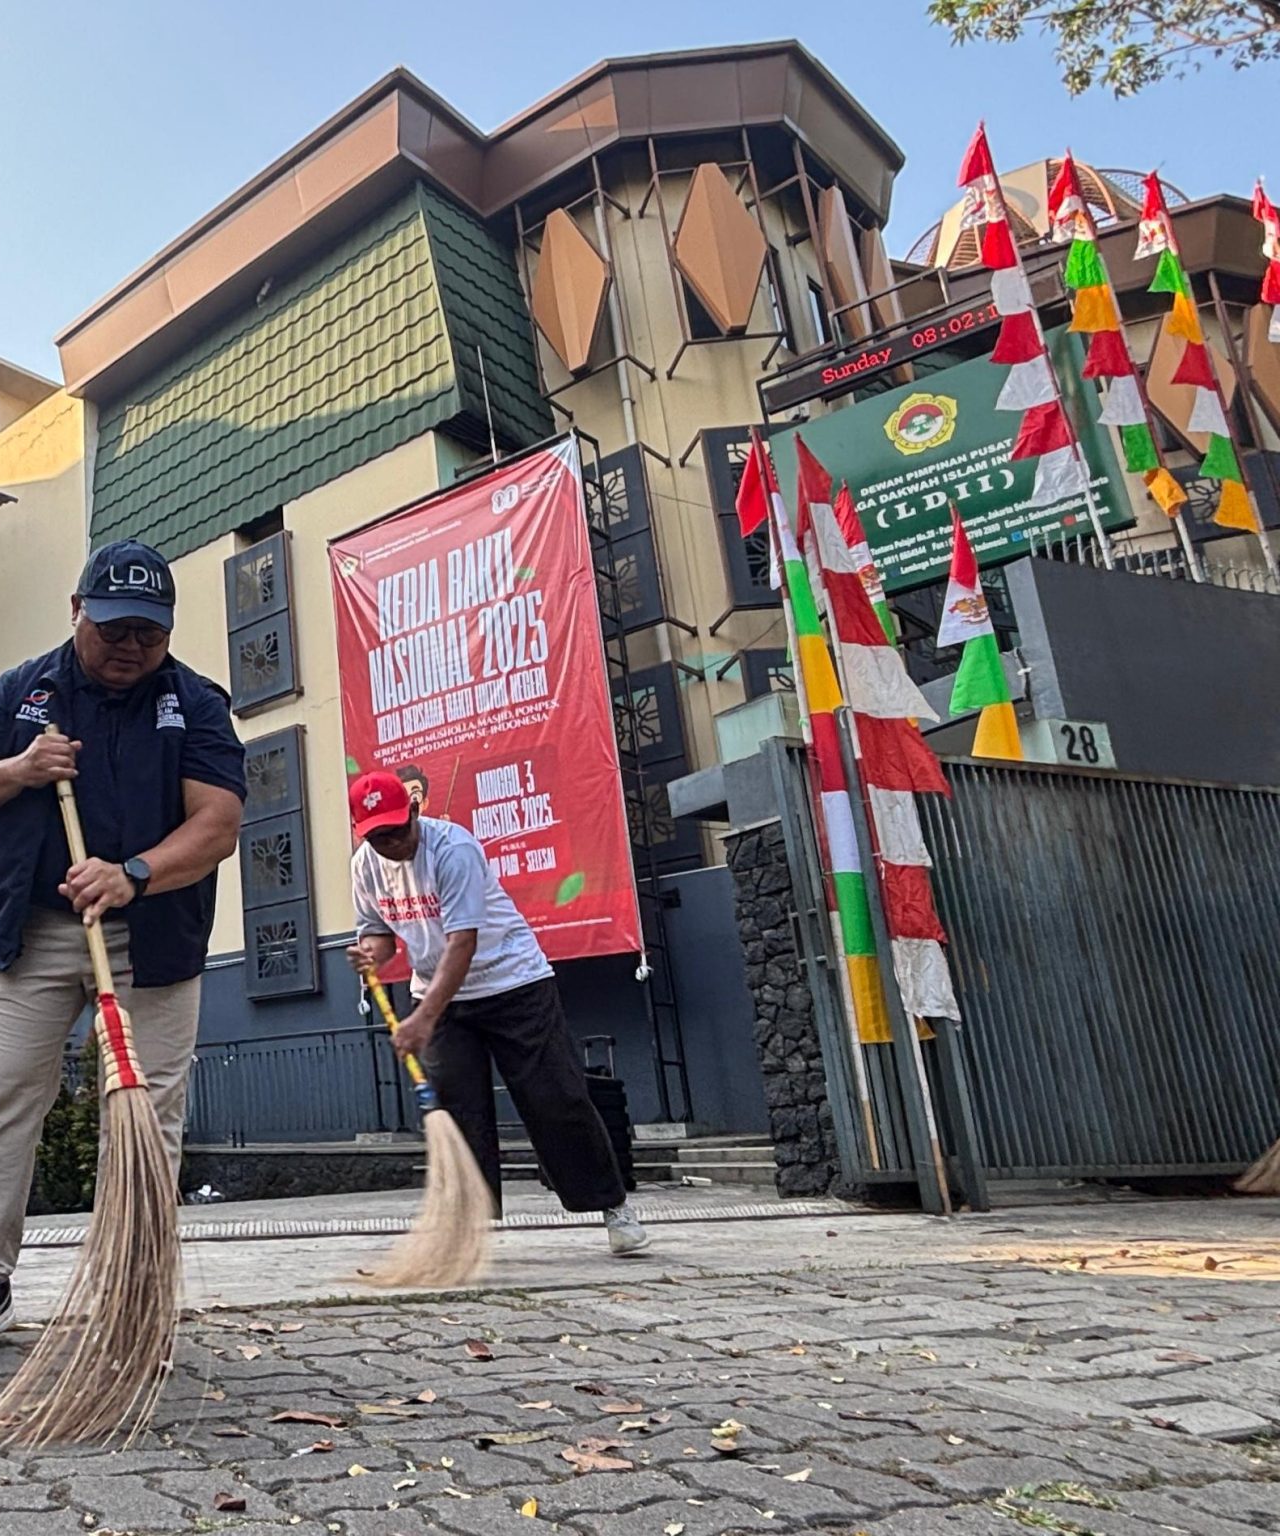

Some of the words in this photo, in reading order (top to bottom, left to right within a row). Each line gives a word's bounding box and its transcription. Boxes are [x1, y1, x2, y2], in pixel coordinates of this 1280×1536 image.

[822, 348, 892, 385] Sunday
[911, 303, 998, 348] 08:02:1
[860, 476, 904, 497] DEWAN
[906, 454, 967, 482] PIMPINAN
[969, 438, 1013, 460] PUSAT
[879, 477, 940, 504] DAKWAH
[943, 461, 988, 483] ISLAM
[110, 564, 162, 590] LDII
[377, 558, 441, 642] KERJA
[447, 526, 515, 616] BAKTI
[368, 615, 475, 715] NASIONAL
[478, 589, 549, 679] 2025
[20, 703, 49, 719] nsc
[377, 710, 403, 746] KERJA
[402, 696, 445, 737] BERSAMA
[445, 686, 474, 724] BAKTI
[474, 676, 509, 714] UNTUK
[509, 664, 549, 704] NEGERI
[414, 736, 424, 747] DI
[414, 745, 433, 757] DPD
[433, 737, 453, 751] DAN
[1060, 724, 1099, 764] 28
[476, 763, 524, 805] MINGGU,
[524, 760, 536, 793] 3
[472, 800, 520, 841] AGUSTUS
[521, 792, 554, 831] 2025
[525, 846, 557, 873] SELESAI
